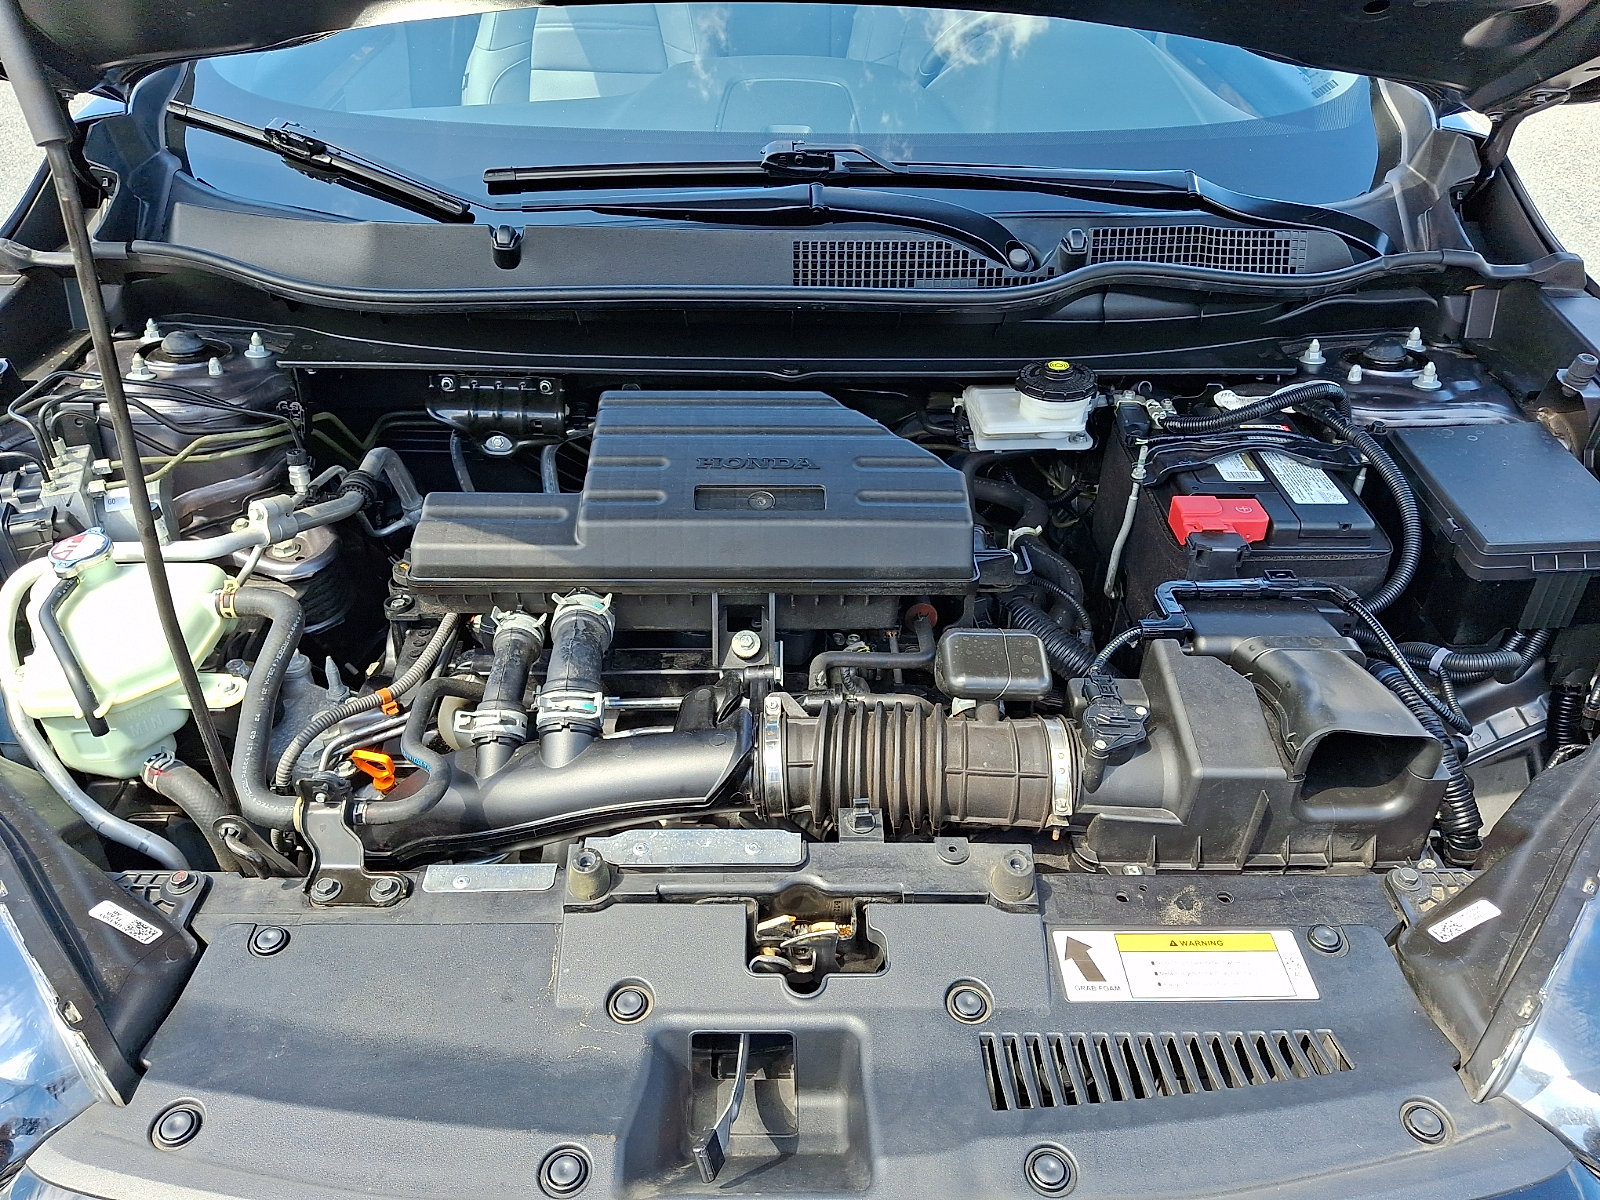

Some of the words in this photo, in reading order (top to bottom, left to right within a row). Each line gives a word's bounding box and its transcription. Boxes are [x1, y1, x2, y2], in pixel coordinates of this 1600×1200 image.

[696, 457, 821, 470] HONDA
[129, 714, 165, 737] MIN
[1179, 939, 1224, 947] WARNING
[1074, 984, 1098, 992] GRAB
[1098, 984, 1122, 992] FOAM
